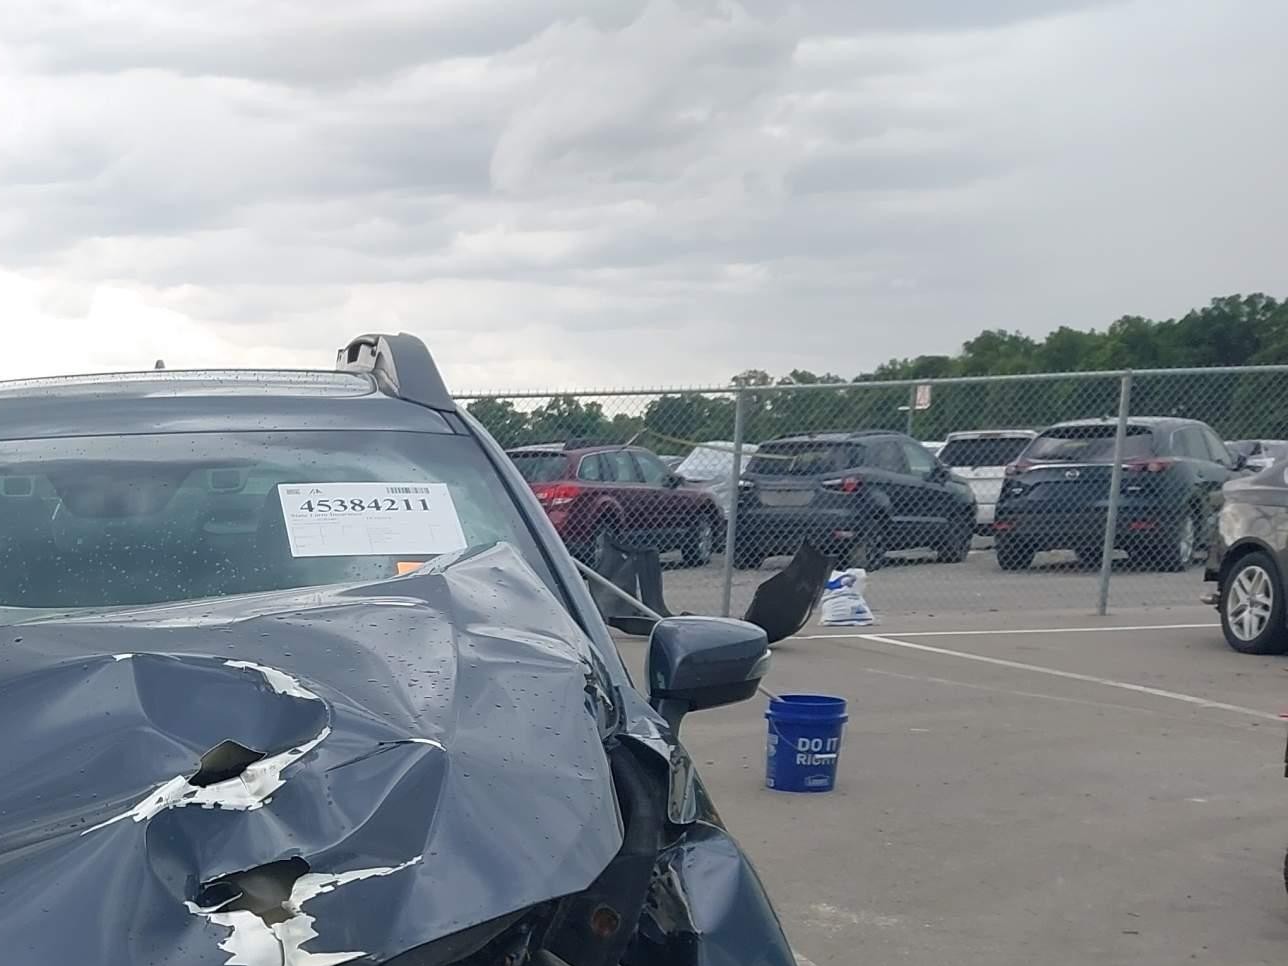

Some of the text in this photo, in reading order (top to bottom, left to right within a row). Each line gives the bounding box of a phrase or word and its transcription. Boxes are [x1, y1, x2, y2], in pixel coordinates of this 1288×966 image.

[300, 498, 430, 513] 45384211
[797, 737, 839, 752] DO IT
